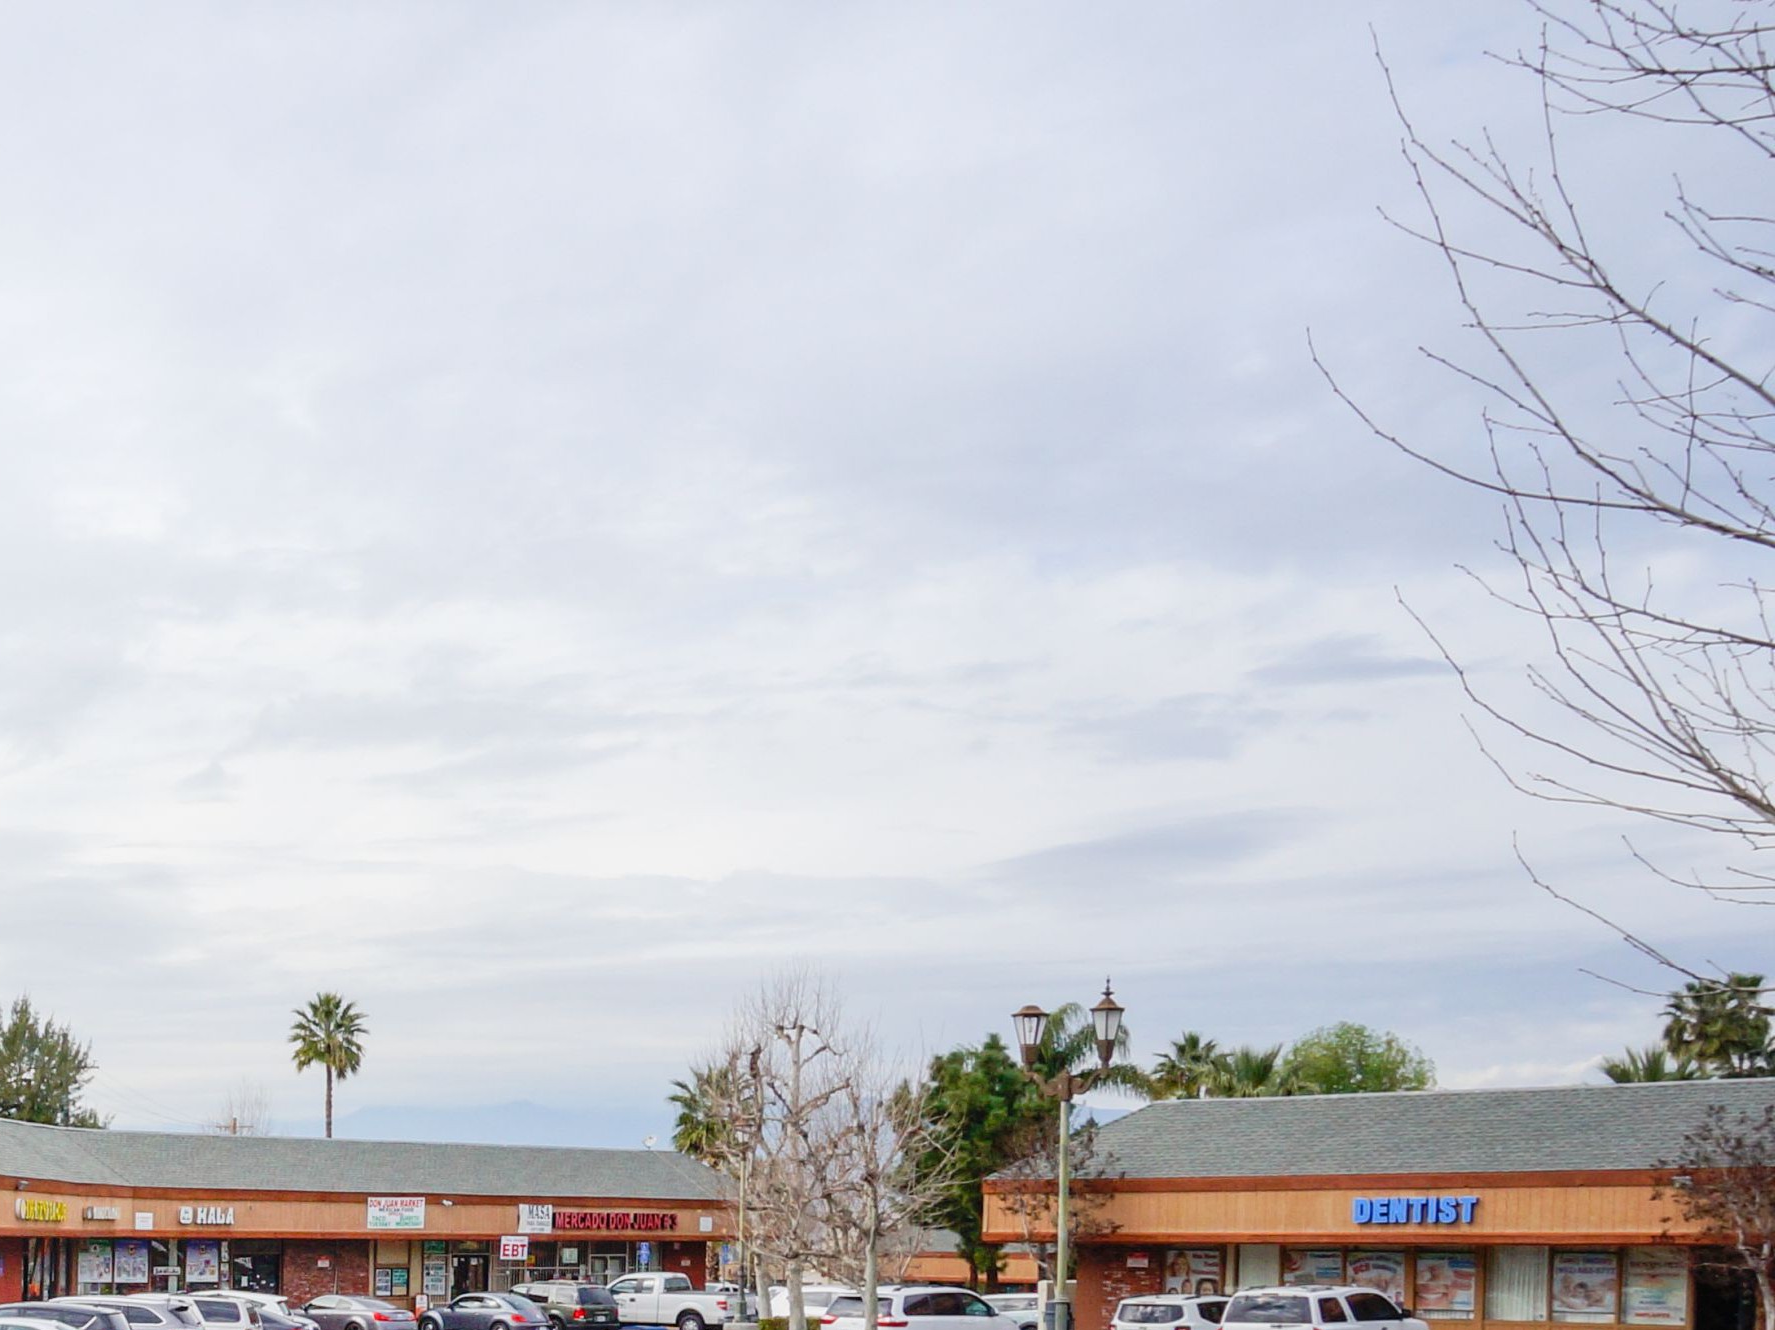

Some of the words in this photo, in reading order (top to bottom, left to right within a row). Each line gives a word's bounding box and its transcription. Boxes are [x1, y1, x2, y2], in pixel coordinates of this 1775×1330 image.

[369, 1200, 382, 1208] DON
[384, 1200, 398, 1208] JUAN
[400, 1199, 423, 1208] MARKET
[1352, 1196, 1478, 1223] DENTIST
[528, 1204, 550, 1219] MASA
[555, 1212, 607, 1229] MERCADO
[610, 1213, 632, 1230] DON
[634, 1213, 662, 1230] JUAN
[502, 1243, 527, 1257] EBT
